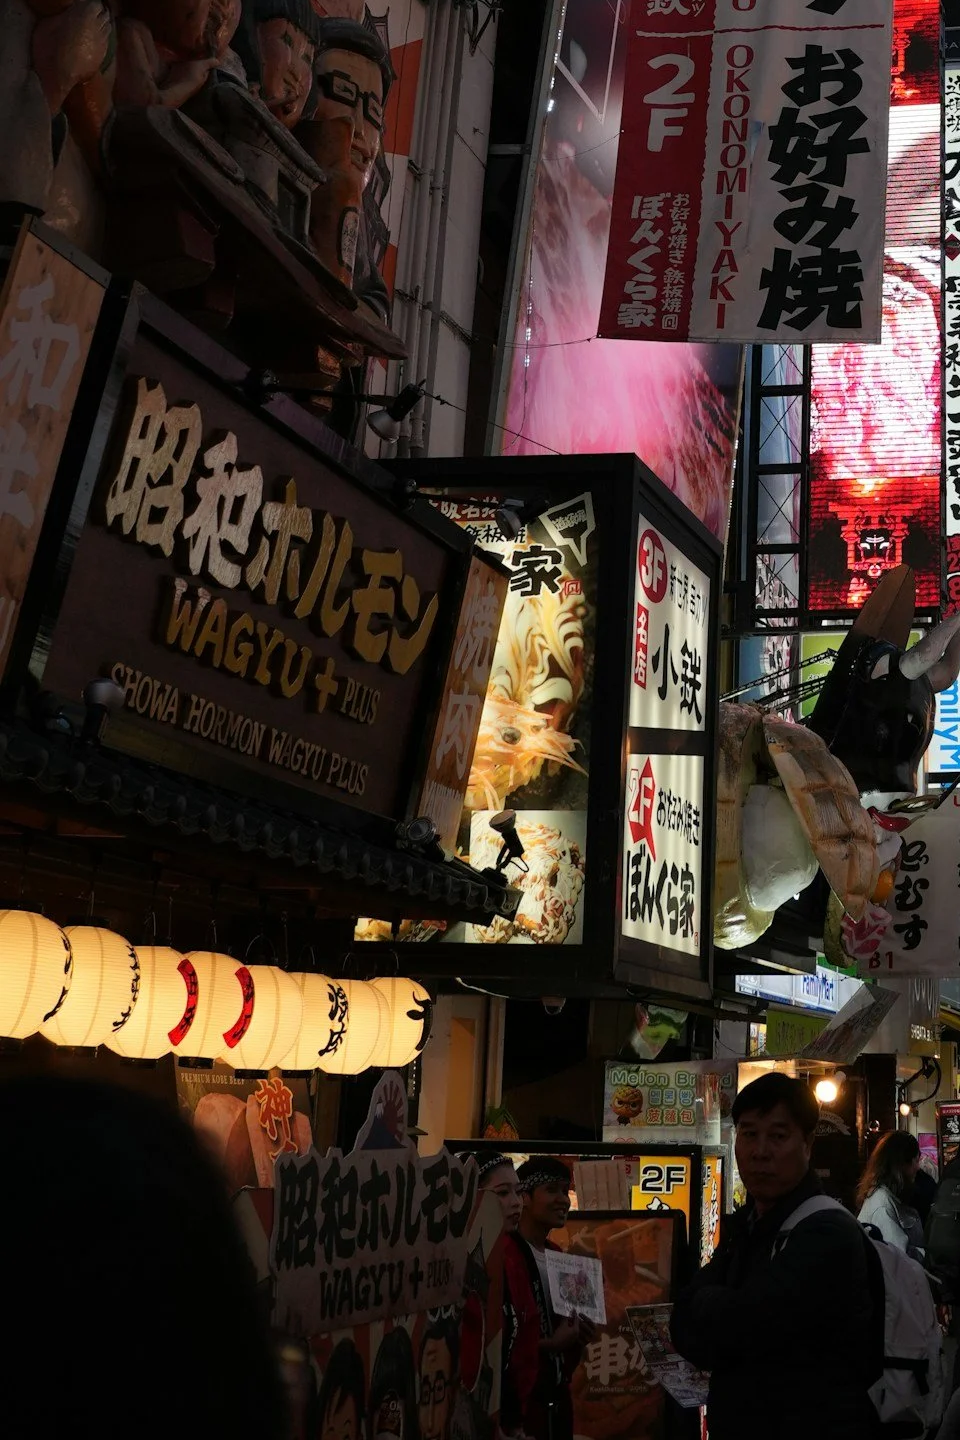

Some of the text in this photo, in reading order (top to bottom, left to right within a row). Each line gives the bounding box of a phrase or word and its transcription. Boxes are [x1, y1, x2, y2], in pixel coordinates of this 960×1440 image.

[643, 53, 696, 153] 2F
[709, 44, 756, 330] OKONOMIYAKI
[757, 44, 872, 331] お好み焼
[617, 191, 671, 330] ぼんくら家
[105, 376, 438, 675] 昭和ホルモン
[640, 536, 666, 595] 3F
[166, 577, 312, 699] WAGYU
[341, 690, 380, 725] PLUS
[635, 609, 649, 685] 名店
[110, 661, 368, 797] SHOWA HORMON WAGYU PLUS
[627, 767, 654, 828] 2F
[656, 786, 700, 847] お好み焼き
[625, 843, 695, 939] ぼんくら家
[180, 1072, 211, 1085] PREMIUM
[211, 1074, 229, 1085] KOBE
[610, 1070, 734, 1087] Melon Brd
[275, 1155, 478, 1272] 昭和ホルモン
[640, 1165, 687, 1194] 2F
[319, 1259, 403, 1321] WAGYU
[426, 1258, 451, 1289] PLUS
